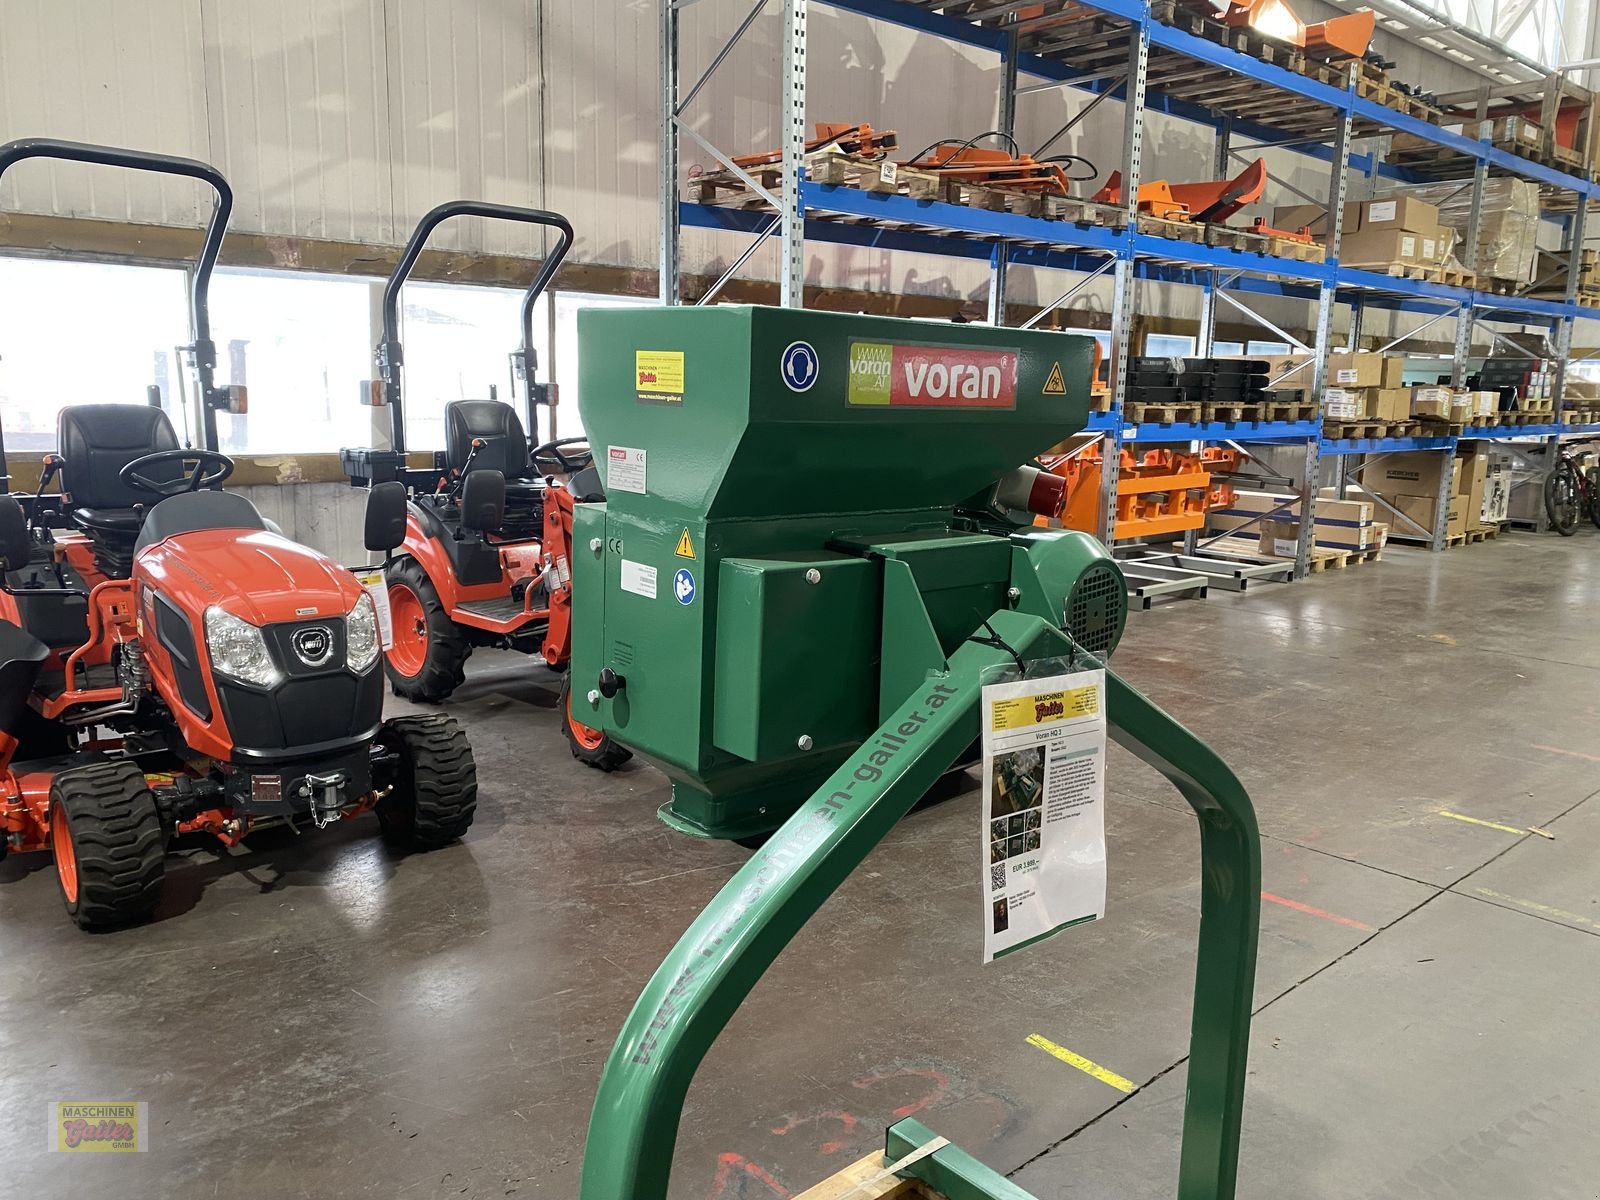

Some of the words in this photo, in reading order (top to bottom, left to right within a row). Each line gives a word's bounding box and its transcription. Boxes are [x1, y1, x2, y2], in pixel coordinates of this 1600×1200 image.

[849, 359, 891, 375] voran
[905, 362, 1001, 399] voran
[609, 538, 621, 554] CE
[1034, 691, 1065, 702] MASCHINEN
[1035, 731, 1050, 740] Voran
[1012, 864, 1023, 873] EUR
